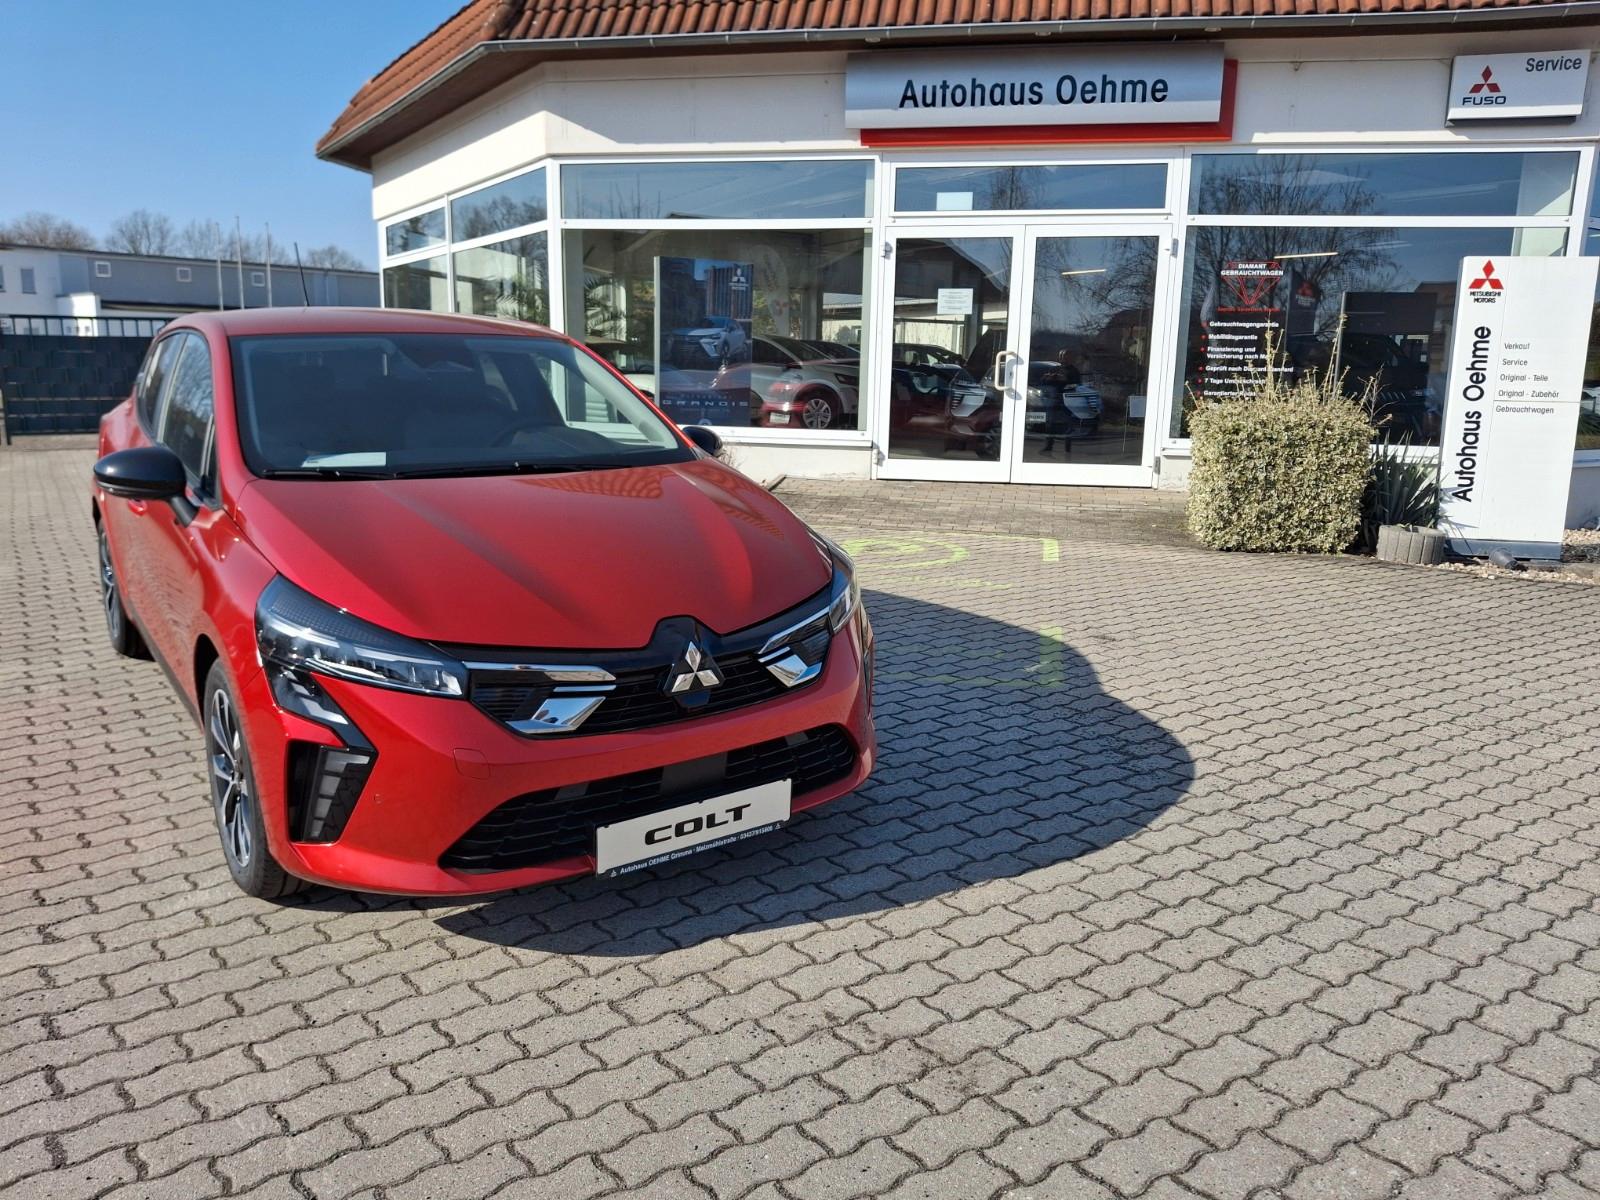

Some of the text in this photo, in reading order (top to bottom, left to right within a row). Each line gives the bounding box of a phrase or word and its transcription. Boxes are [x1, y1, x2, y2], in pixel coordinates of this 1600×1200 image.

[1525, 56, 1582, 72] Service
[899, 74, 1169, 108] Autohaus Oehme
[1462, 96, 1507, 106] FUSO
[1500, 374, 1526, 382] Original
[1498, 390, 1524, 398] Original
[1531, 390, 1560, 398] Zubehör
[1452, 326, 1491, 502] Autohaus Oehme
[1496, 406, 1554, 414] Gebrauchtwagen
[644, 803, 752, 845] COLT
[620, 862, 648, 874] Autohaus
[648, 854, 670, 866] OEHME
